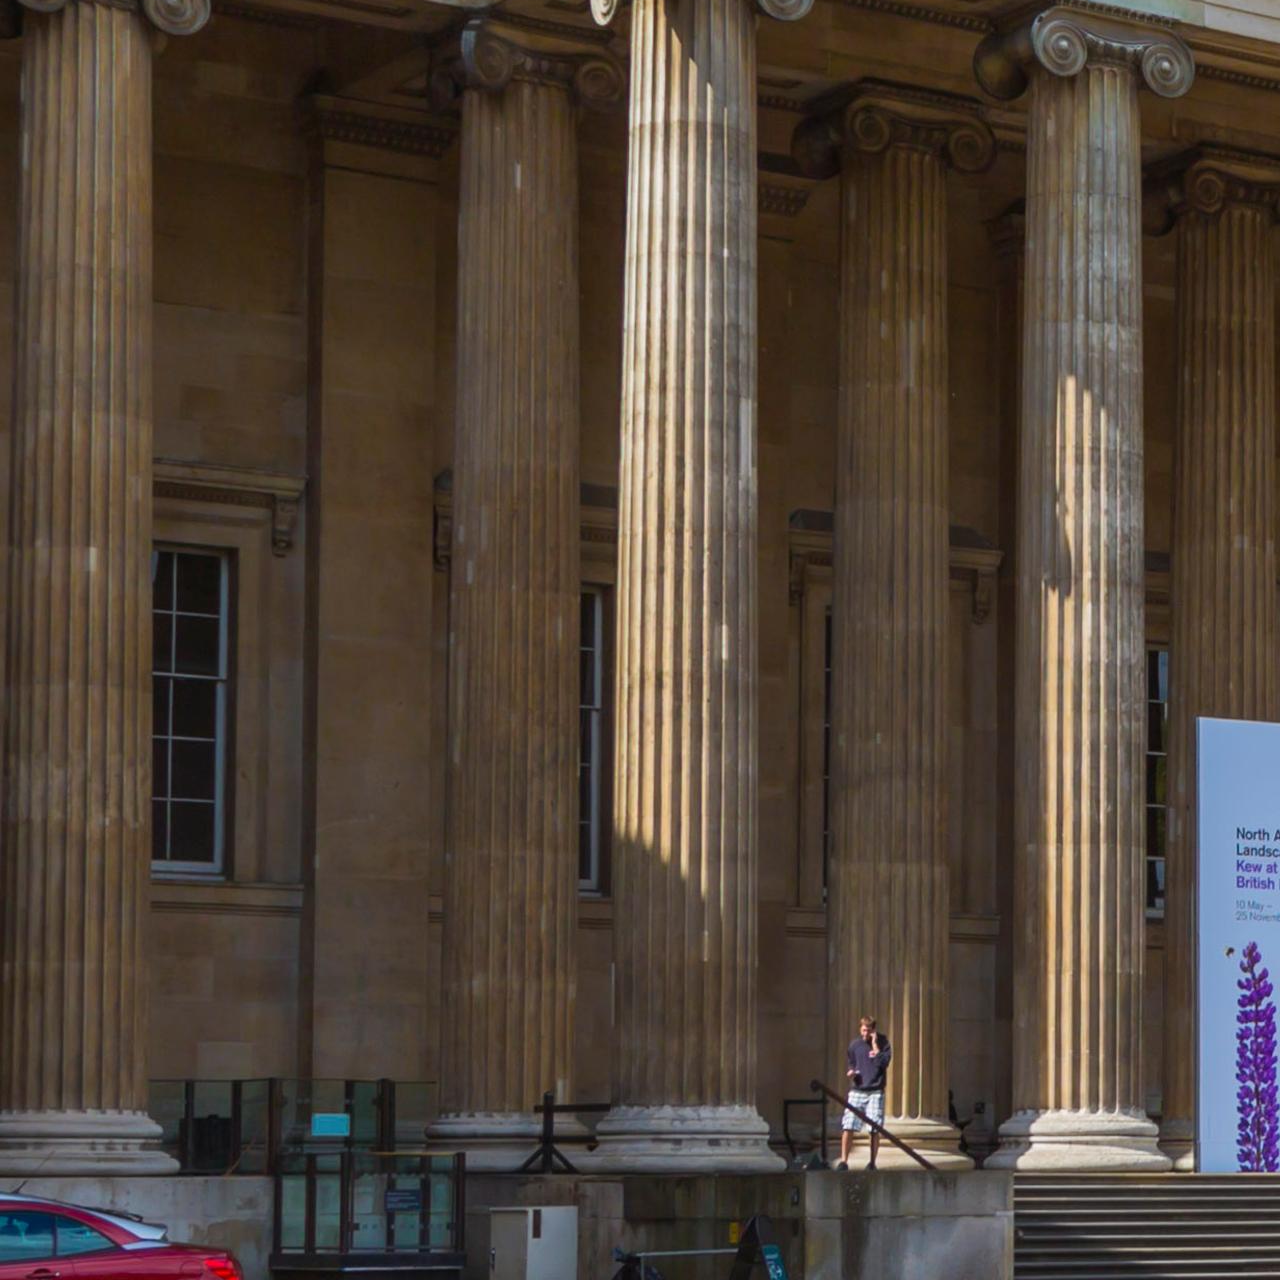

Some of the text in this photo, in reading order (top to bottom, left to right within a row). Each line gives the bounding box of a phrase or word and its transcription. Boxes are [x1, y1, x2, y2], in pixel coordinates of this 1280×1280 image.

[1236, 827, 1269, 841] North
[1236, 860, 1262, 873] Kew
[1266, 862, 1278, 874] at
[1236, 876, 1275, 890] British
[1248, 901, 1264, 911] May
